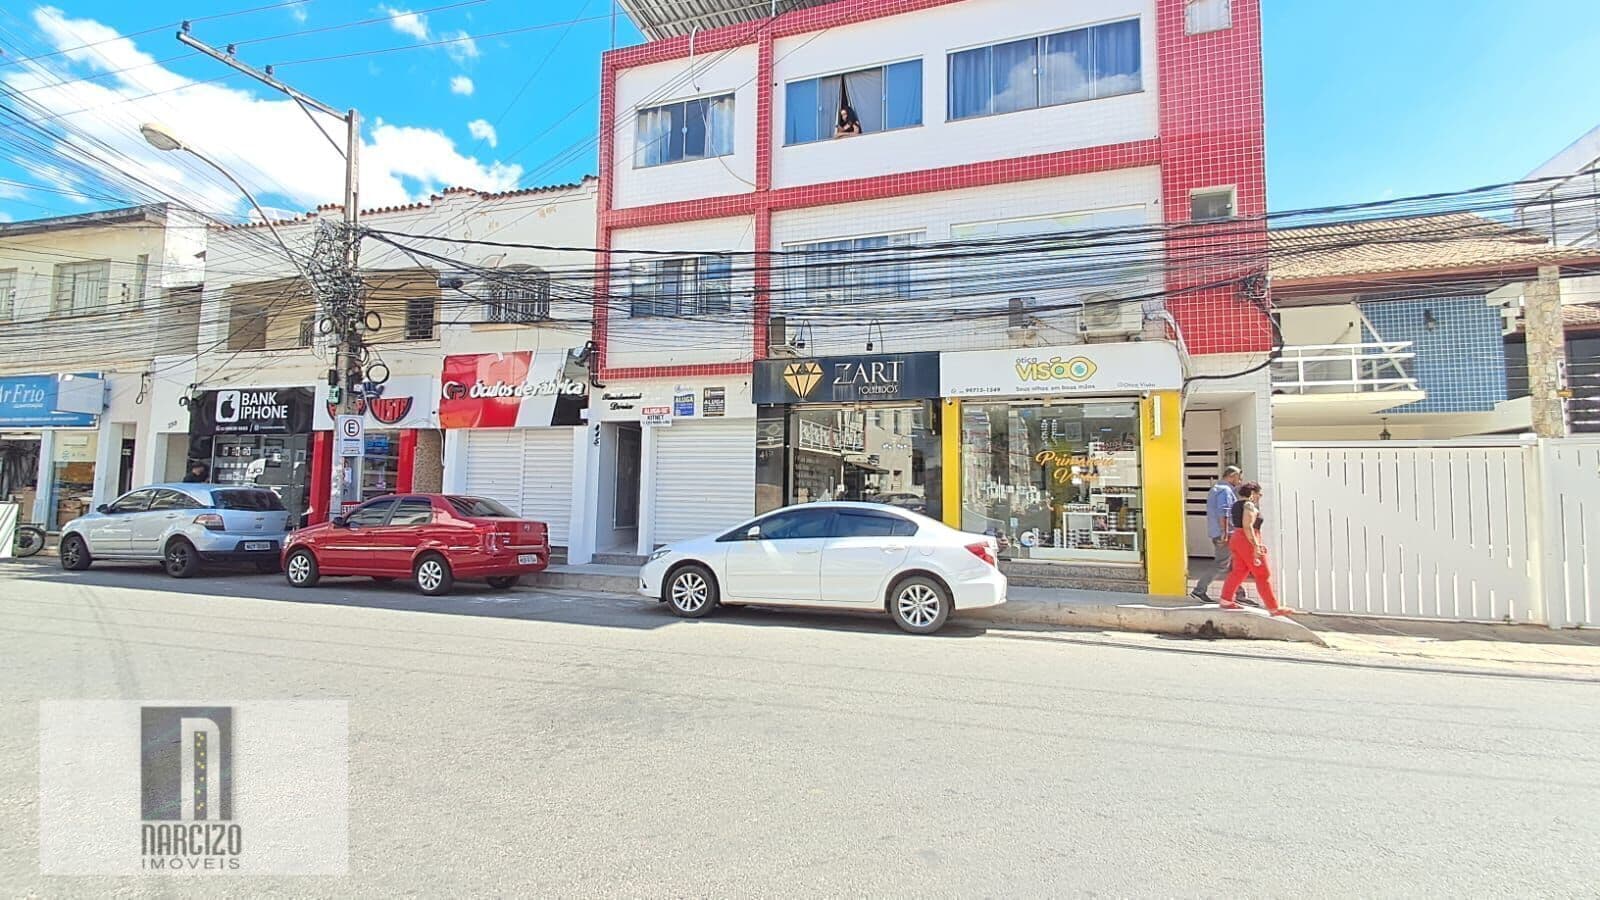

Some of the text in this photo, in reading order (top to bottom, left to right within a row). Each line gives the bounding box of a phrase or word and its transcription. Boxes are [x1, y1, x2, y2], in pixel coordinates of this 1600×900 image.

[833, 360, 905, 385] ZART
[241, 391, 278, 406] BANK
[240, 405, 288, 420] IPHONE
[347, 422, 356, 435] E
